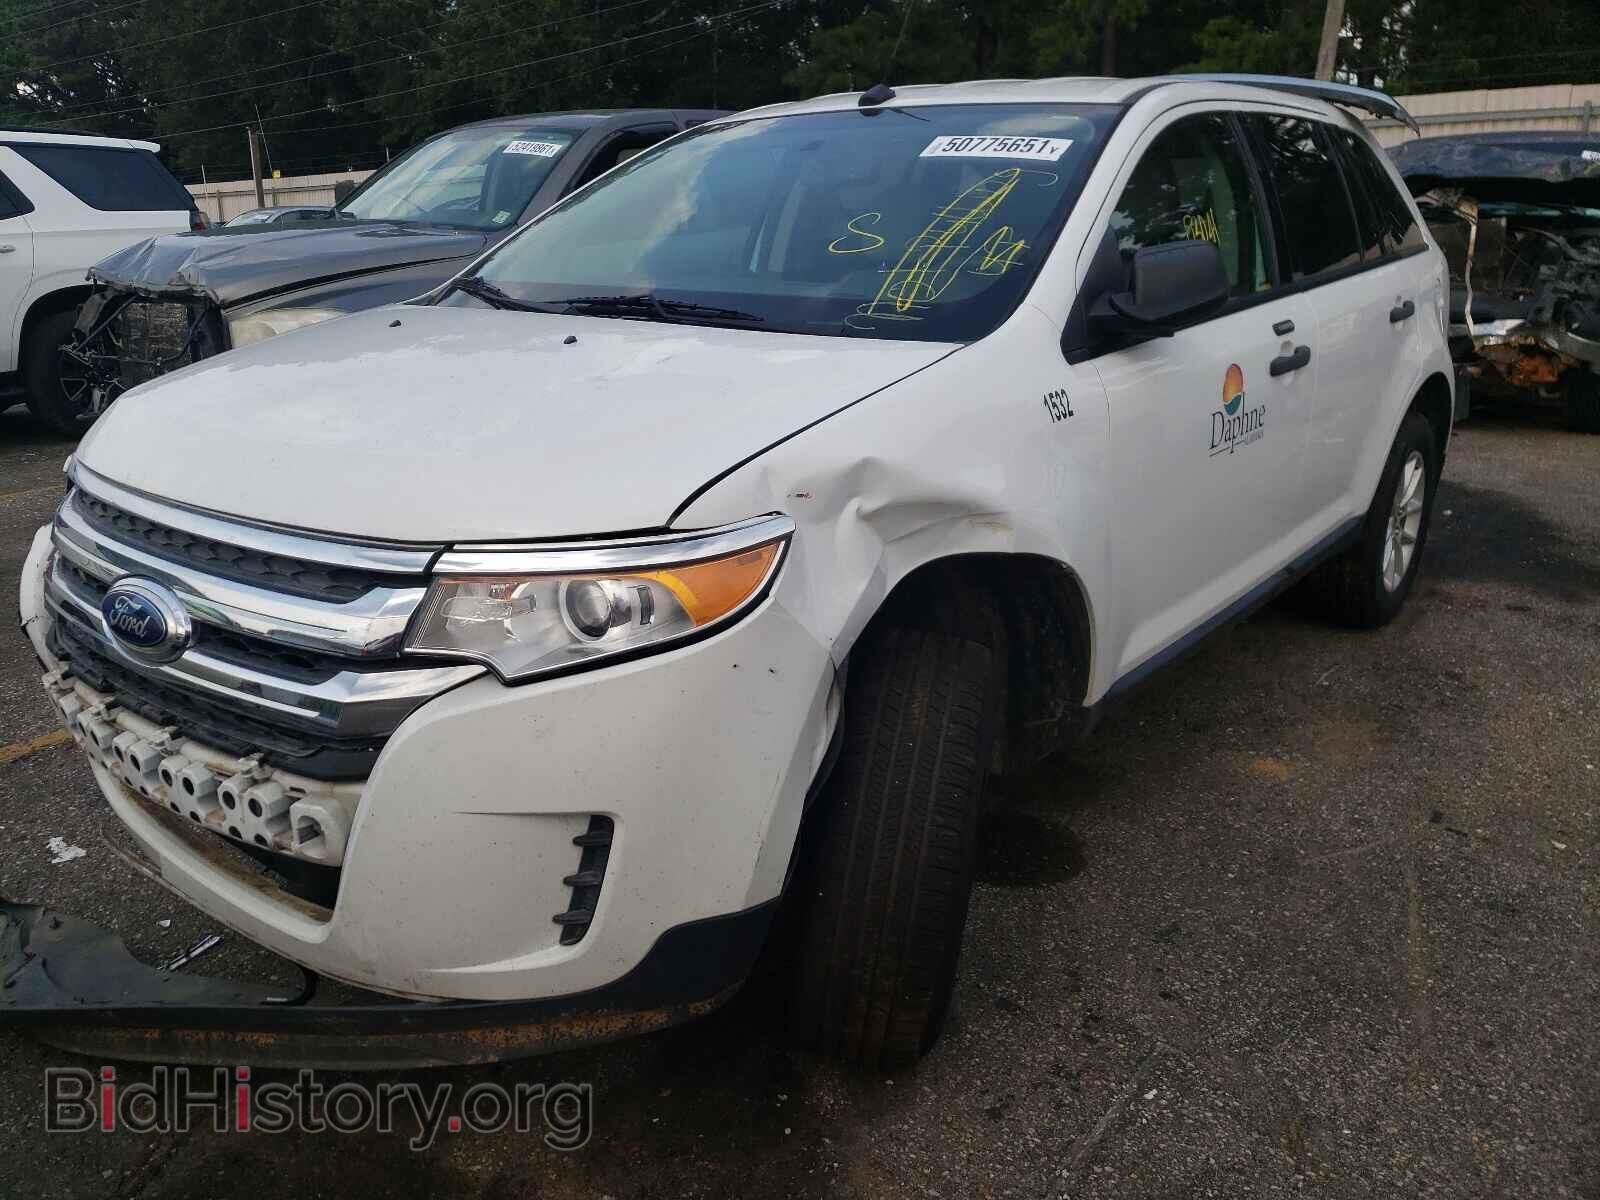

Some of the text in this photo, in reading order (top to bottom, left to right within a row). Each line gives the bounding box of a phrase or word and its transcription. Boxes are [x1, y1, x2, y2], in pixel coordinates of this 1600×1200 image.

[942, 137, 1049, 154] 50775651
[1043, 388, 1074, 424] 1532
[1209, 392, 1266, 454] Daphne
[109, 595, 151, 638] Ford
